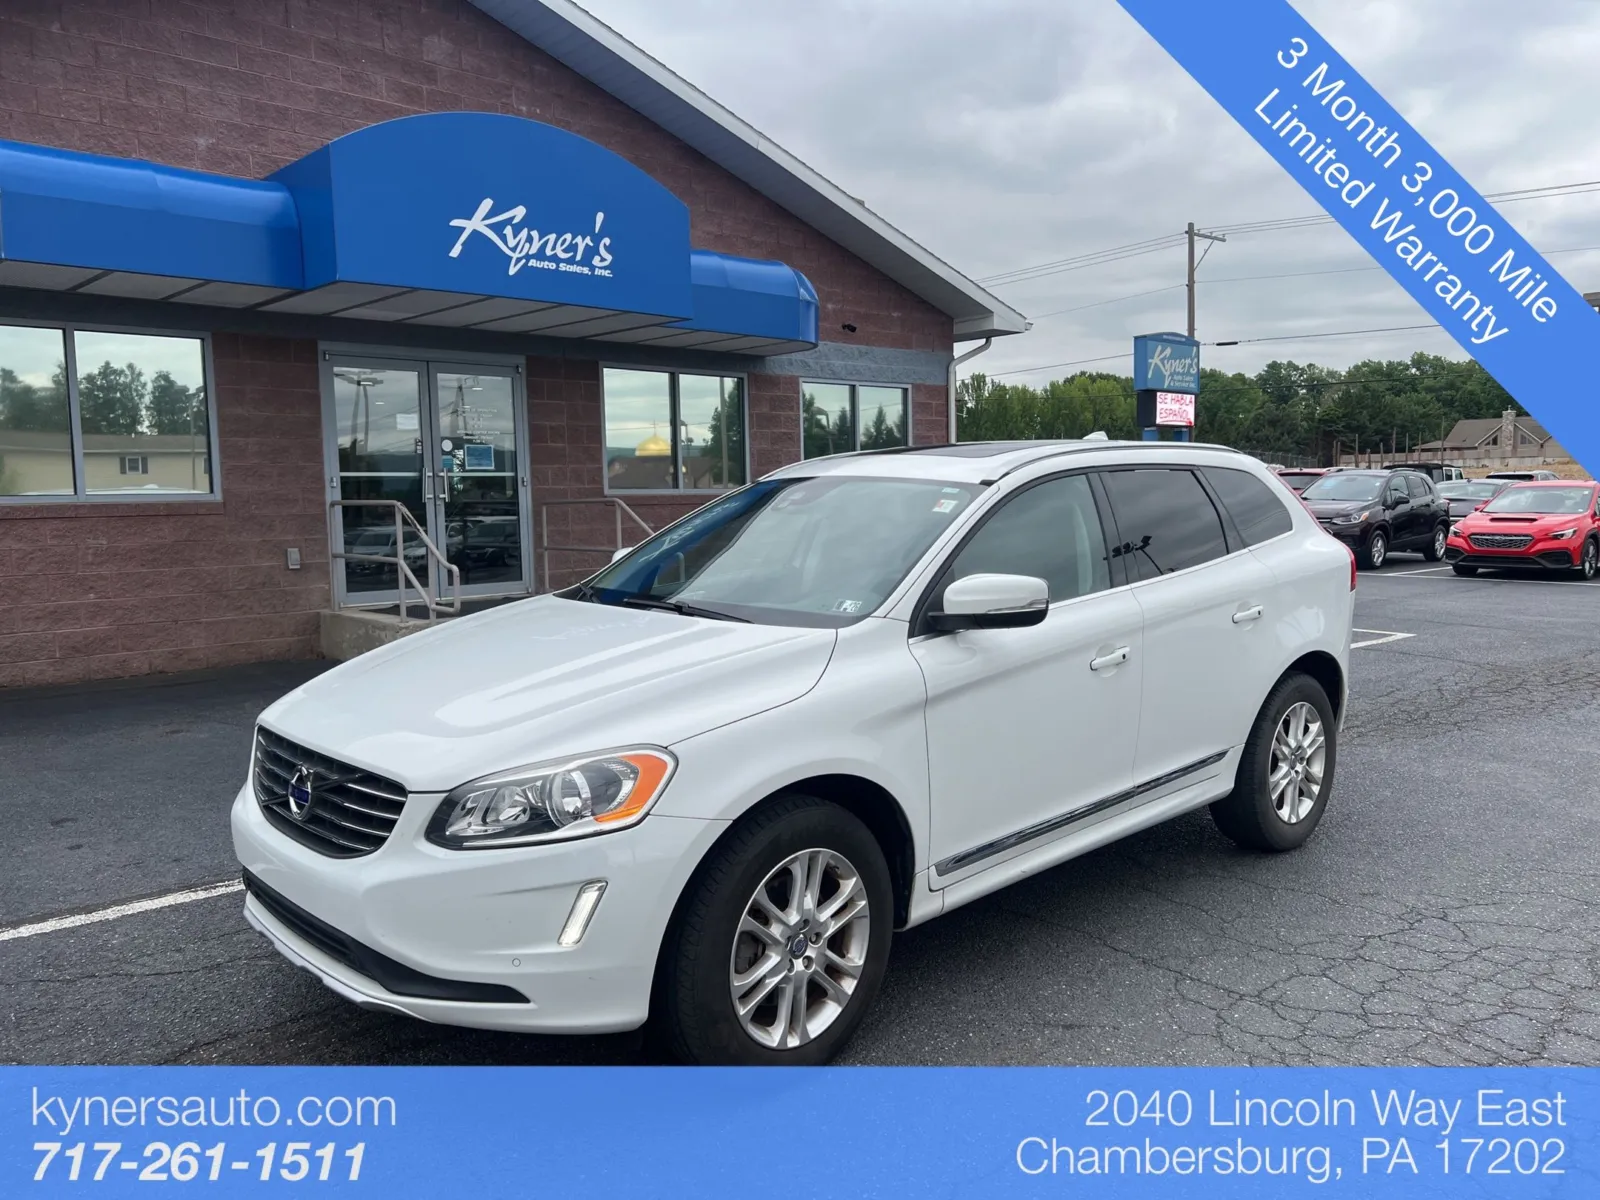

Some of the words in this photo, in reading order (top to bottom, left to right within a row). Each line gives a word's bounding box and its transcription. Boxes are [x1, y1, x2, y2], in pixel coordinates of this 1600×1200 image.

[449, 197, 613, 276] Kyner's
[528, 258, 557, 270] Auto
[558, 262, 592, 275] Sales,
[594, 267, 613, 277] Inc.
[1148, 344, 1197, 388] Kyner's
[1158, 393, 1168, 405] SE
[1170, 394, 1194, 406] HABLA
